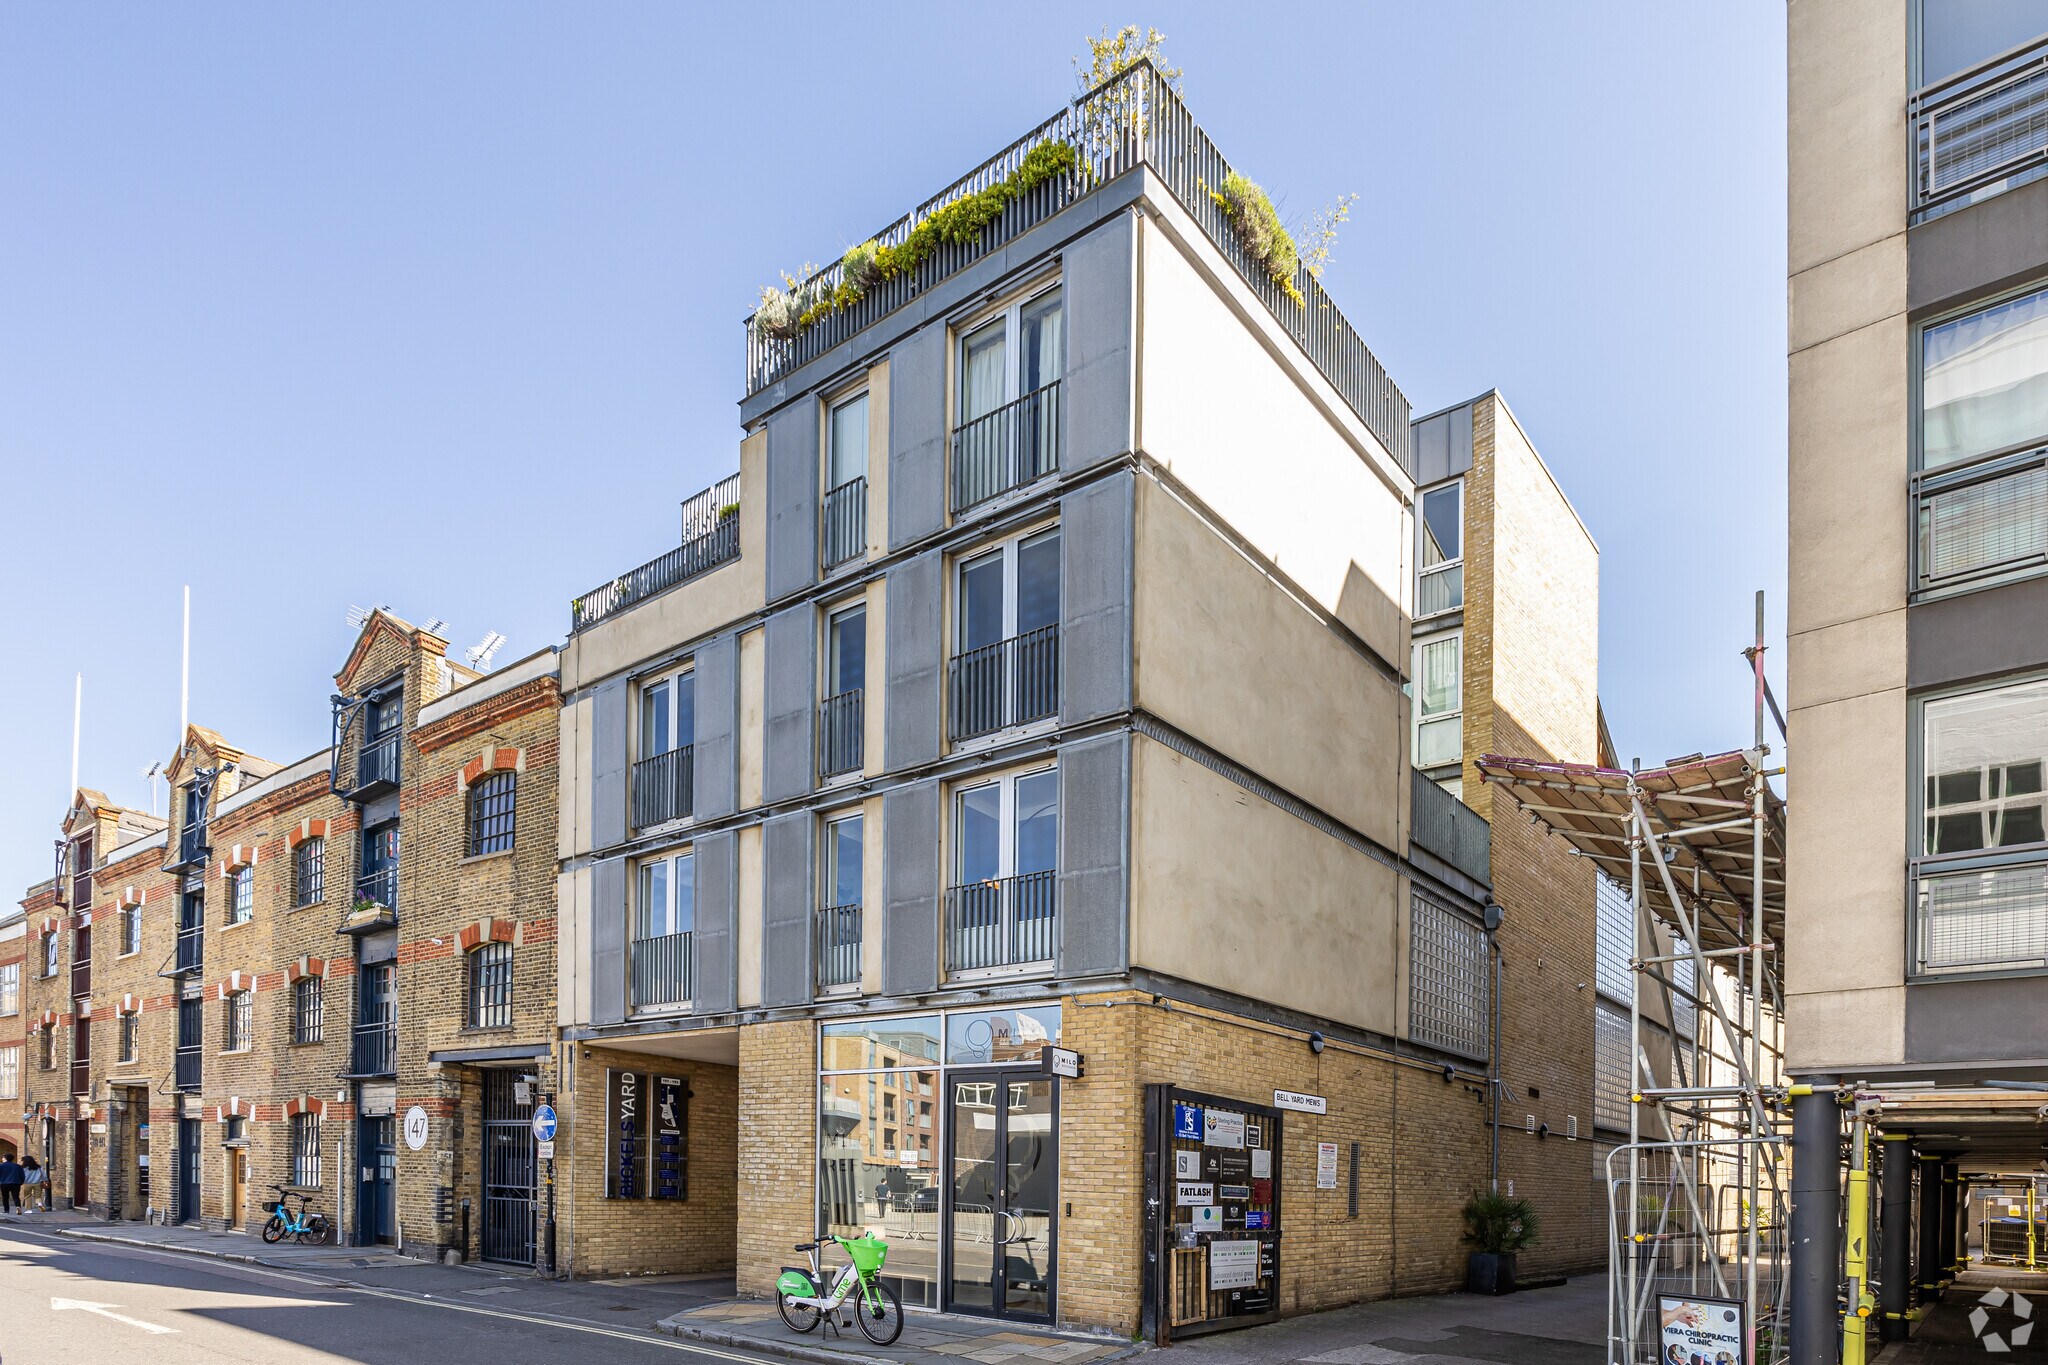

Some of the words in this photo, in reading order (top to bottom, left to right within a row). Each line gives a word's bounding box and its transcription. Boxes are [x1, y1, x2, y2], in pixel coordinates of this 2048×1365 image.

[1061, 1058, 1077, 1066] MILO
[621, 1072, 635, 1119] YARD
[1276, 1093, 1290, 1103] BELL
[1290, 1095, 1305, 1105] YARD
[1305, 1098, 1321, 1107] MEWS
[407, 1118, 426, 1139] 147
[1180, 1187, 1212, 1197] FATLASH
[1664, 1327, 1685, 1336] VIERA
[1685, 1329, 1739, 1344] CHIROPRACTIC
[1688, 1337, 1713, 1347] CLINIC
